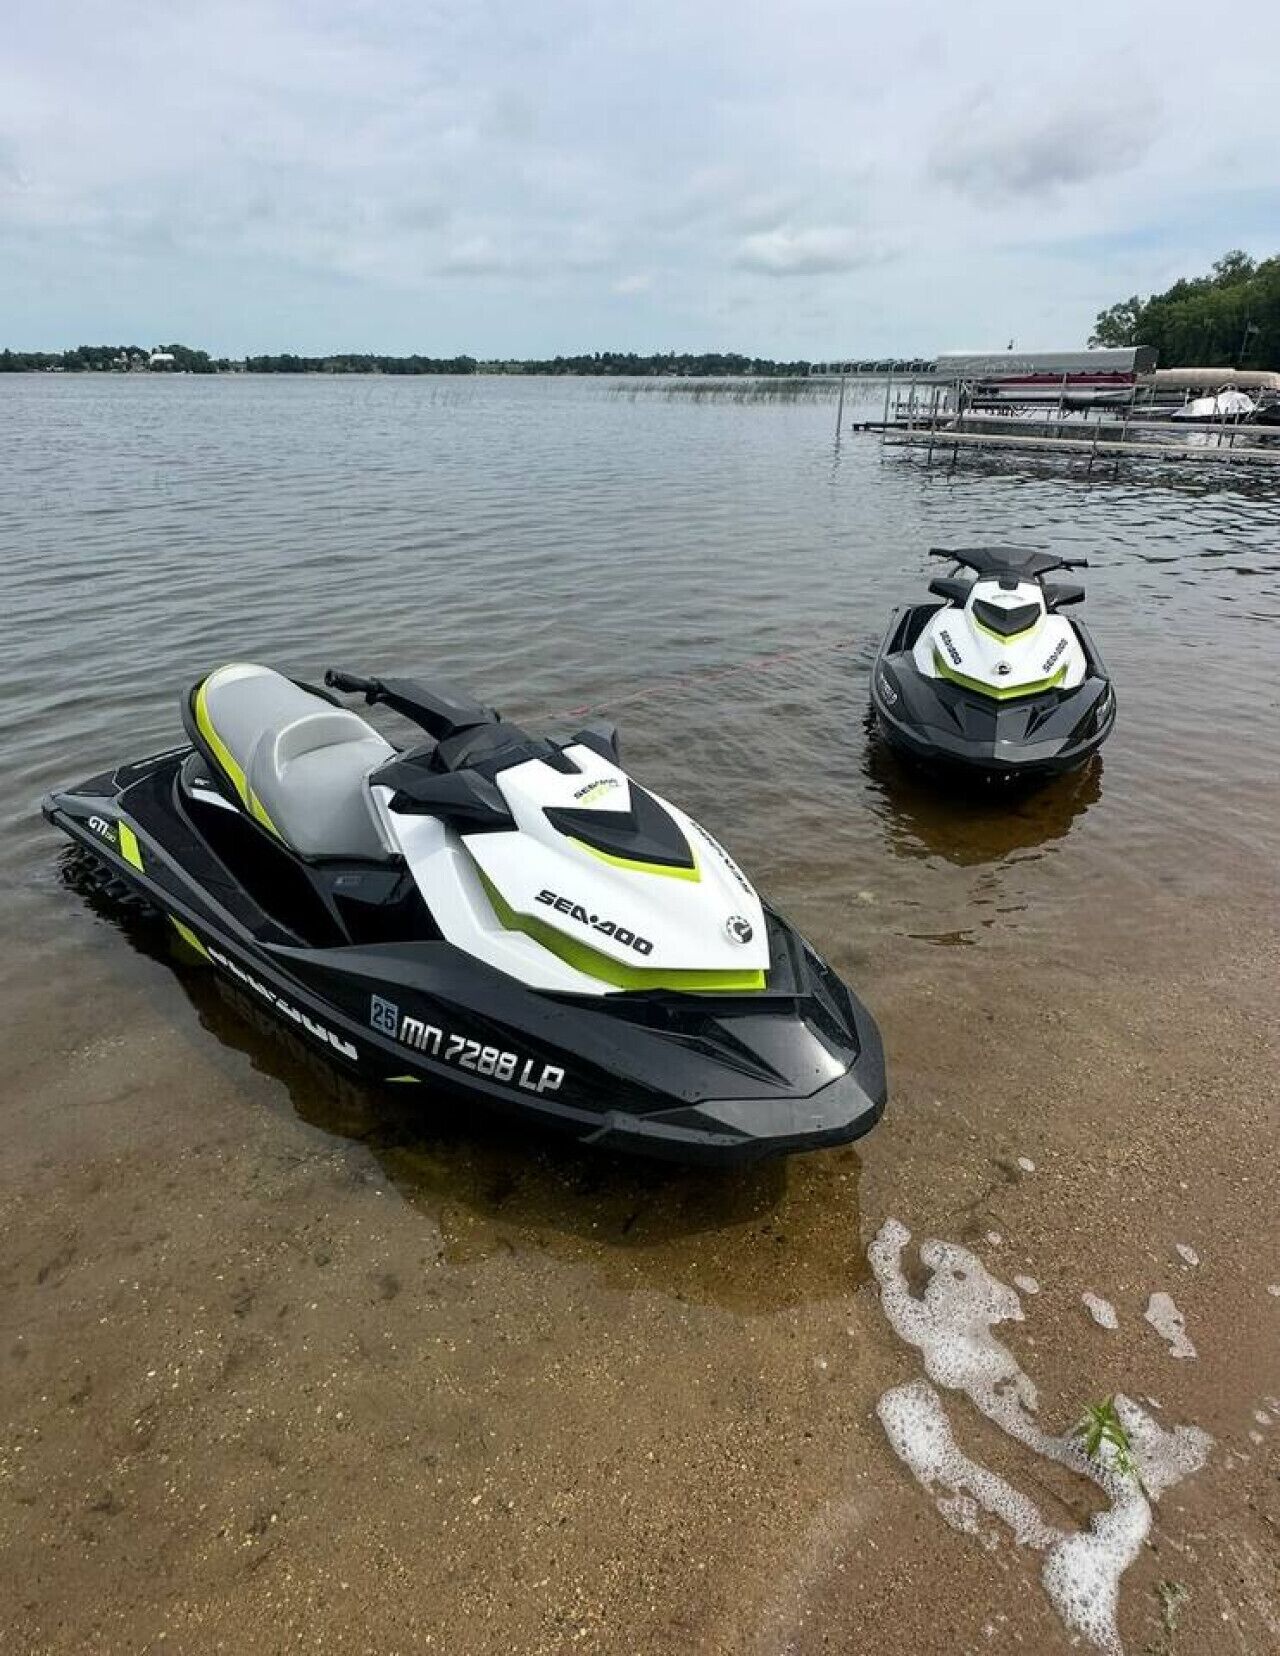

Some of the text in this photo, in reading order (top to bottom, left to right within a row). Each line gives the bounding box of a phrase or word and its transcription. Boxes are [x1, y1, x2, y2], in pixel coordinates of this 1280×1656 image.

[374, 1003, 397, 1032] 25
[445, 1034, 516, 1081] 7288
[518, 1057, 566, 1093] LP
